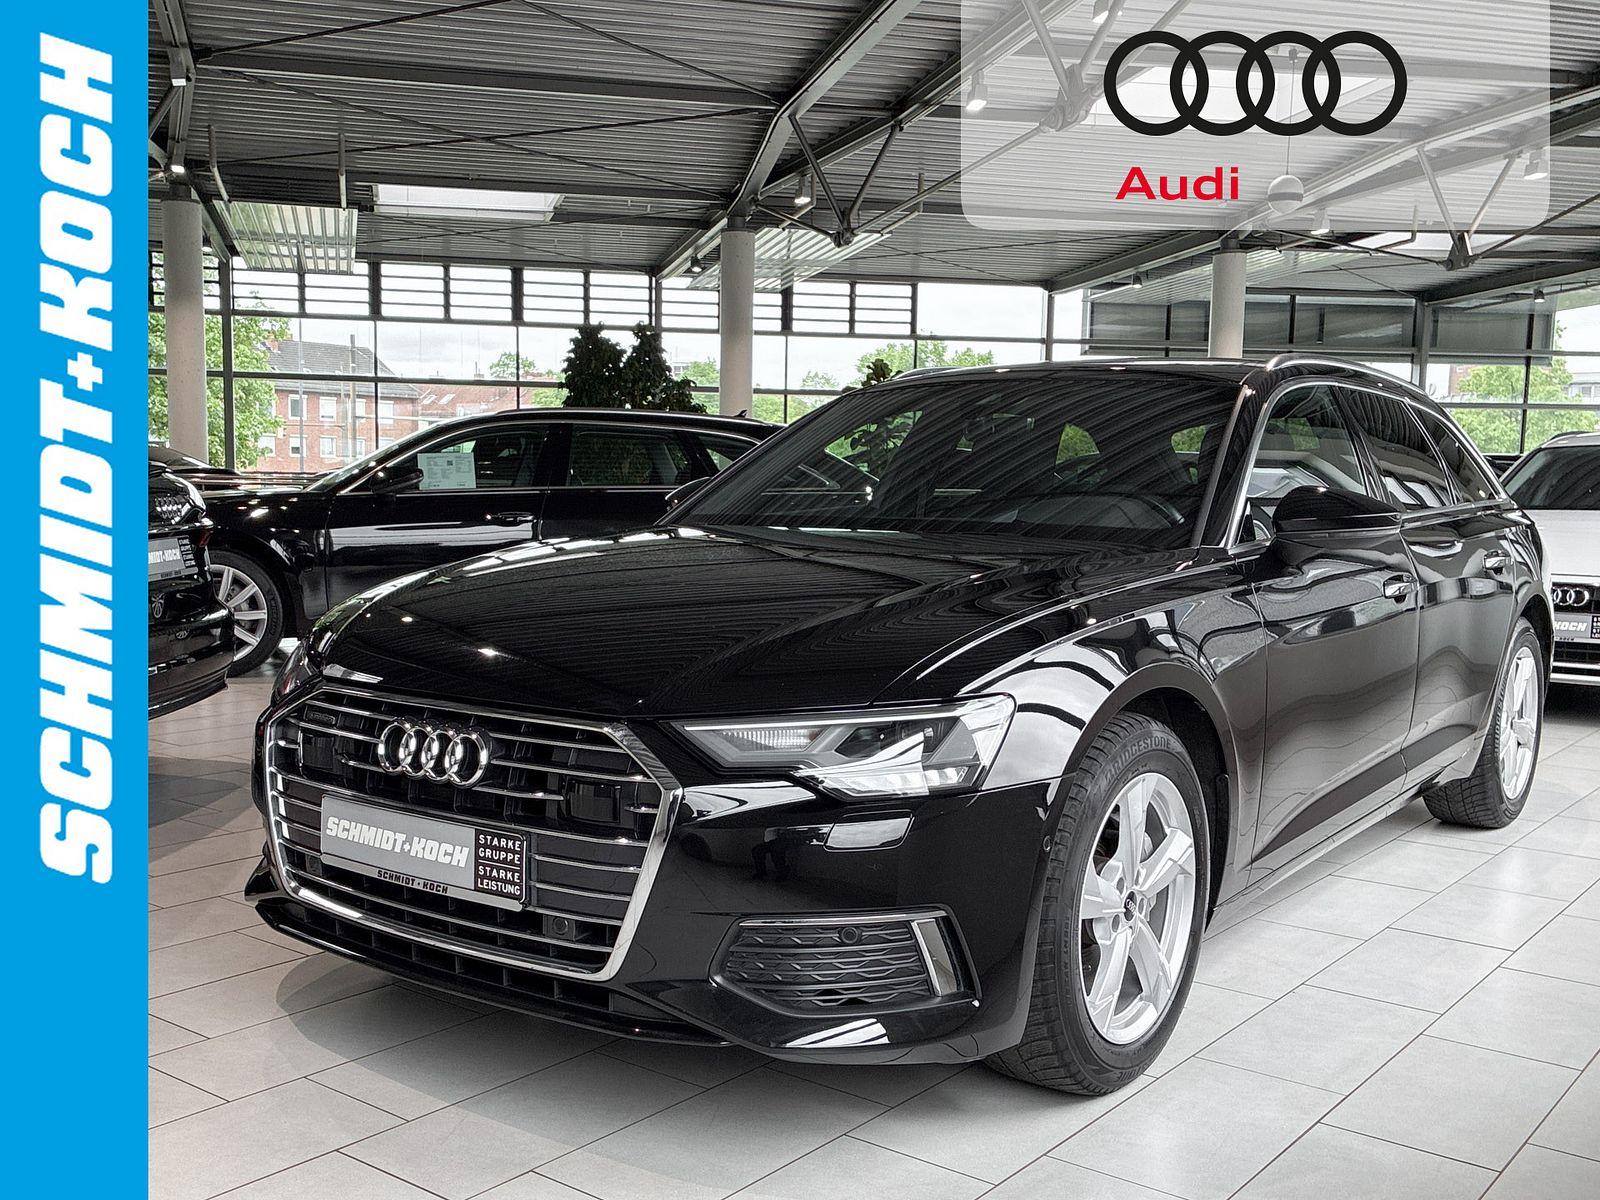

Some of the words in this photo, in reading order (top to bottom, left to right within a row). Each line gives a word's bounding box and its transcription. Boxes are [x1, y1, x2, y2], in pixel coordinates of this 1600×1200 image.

[326, 816, 470, 868] SCHMIDT+KOCH
[478, 834, 521, 851] STARKE
[478, 847, 521, 864] GRUPPE
[377, 869, 416, 887] SCHMIDT
[422, 880, 449, 895] KOCH
[478, 865, 520, 882] STARKE
[477, 878, 521, 895] LEISTUNG
